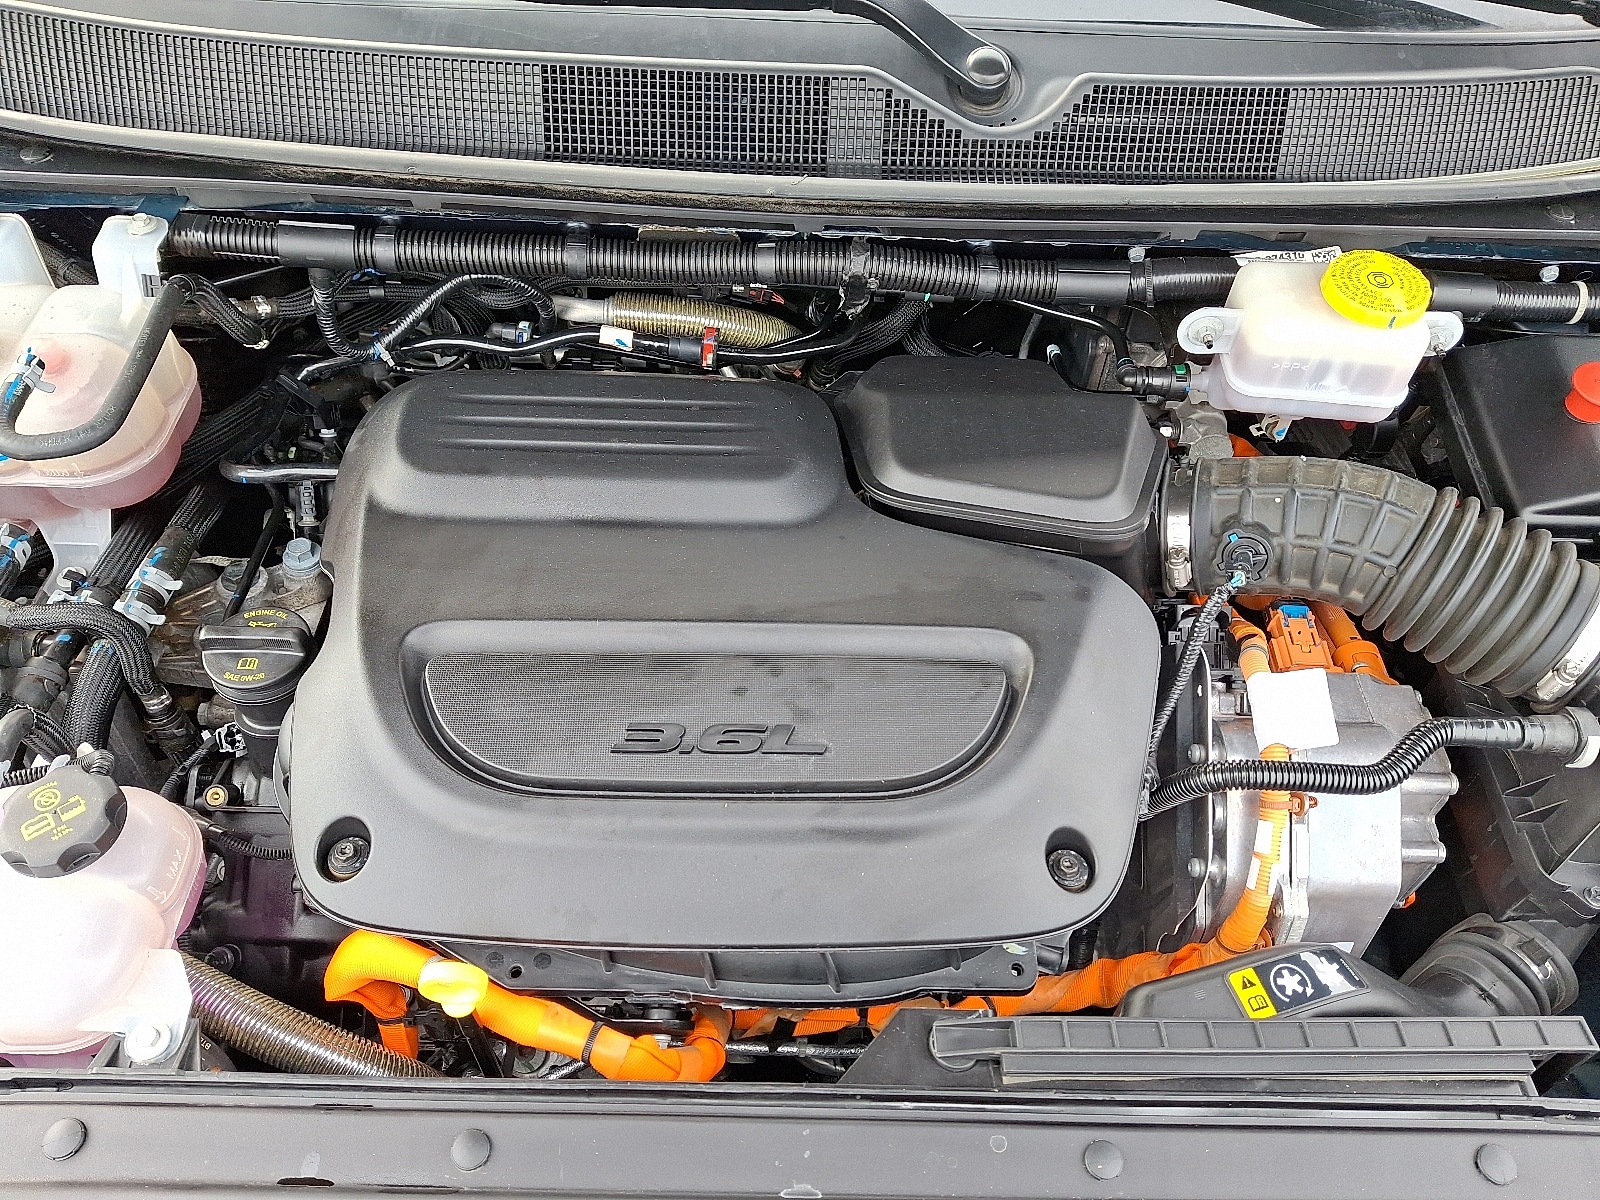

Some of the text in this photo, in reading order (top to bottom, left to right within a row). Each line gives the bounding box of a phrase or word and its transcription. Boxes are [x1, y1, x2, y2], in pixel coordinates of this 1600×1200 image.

[243, 610, 289, 620] ENGINE OIL
[223, 672, 266, 682] SAE 0W-20
[610, 722, 828, 755] 3.6L
[166, 848, 184, 880] MAX
